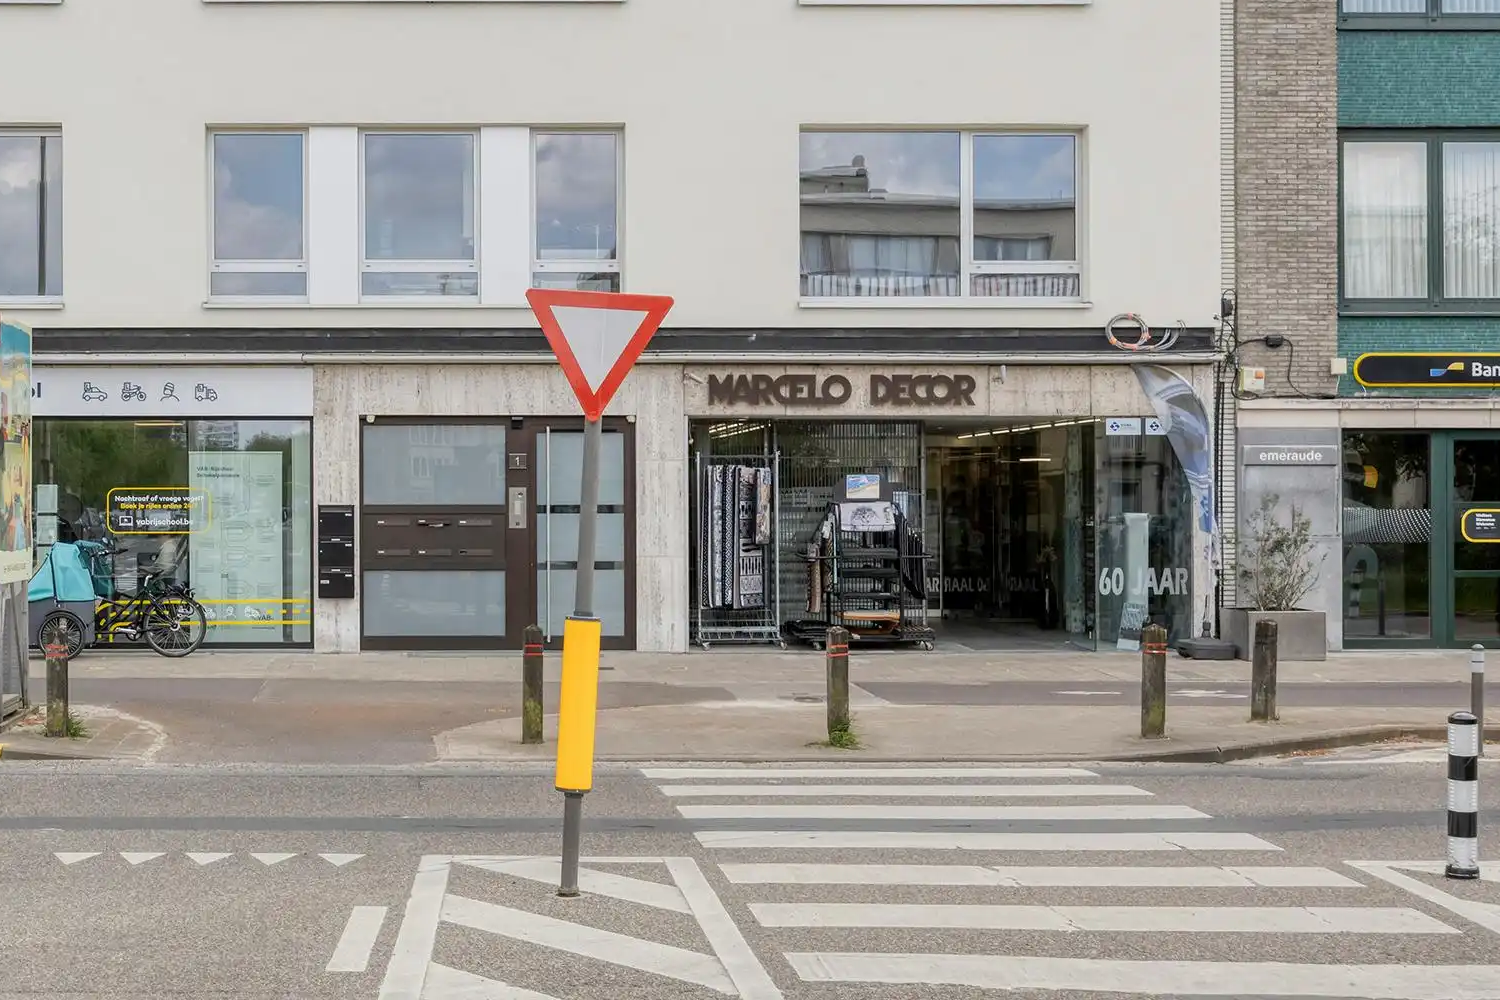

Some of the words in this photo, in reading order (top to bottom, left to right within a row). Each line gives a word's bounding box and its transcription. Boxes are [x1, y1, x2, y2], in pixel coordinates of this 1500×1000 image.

[708, 375, 852, 405] MARCELO
[870, 375, 976, 406] DECOR
[516, 456, 520, 466] 1
[1260, 450, 1323, 461] emeraude
[136, 518, 193, 527] vabrijschool.be
[1100, 567, 1125, 596] 60
[1131, 567, 1189, 596] JAAR
